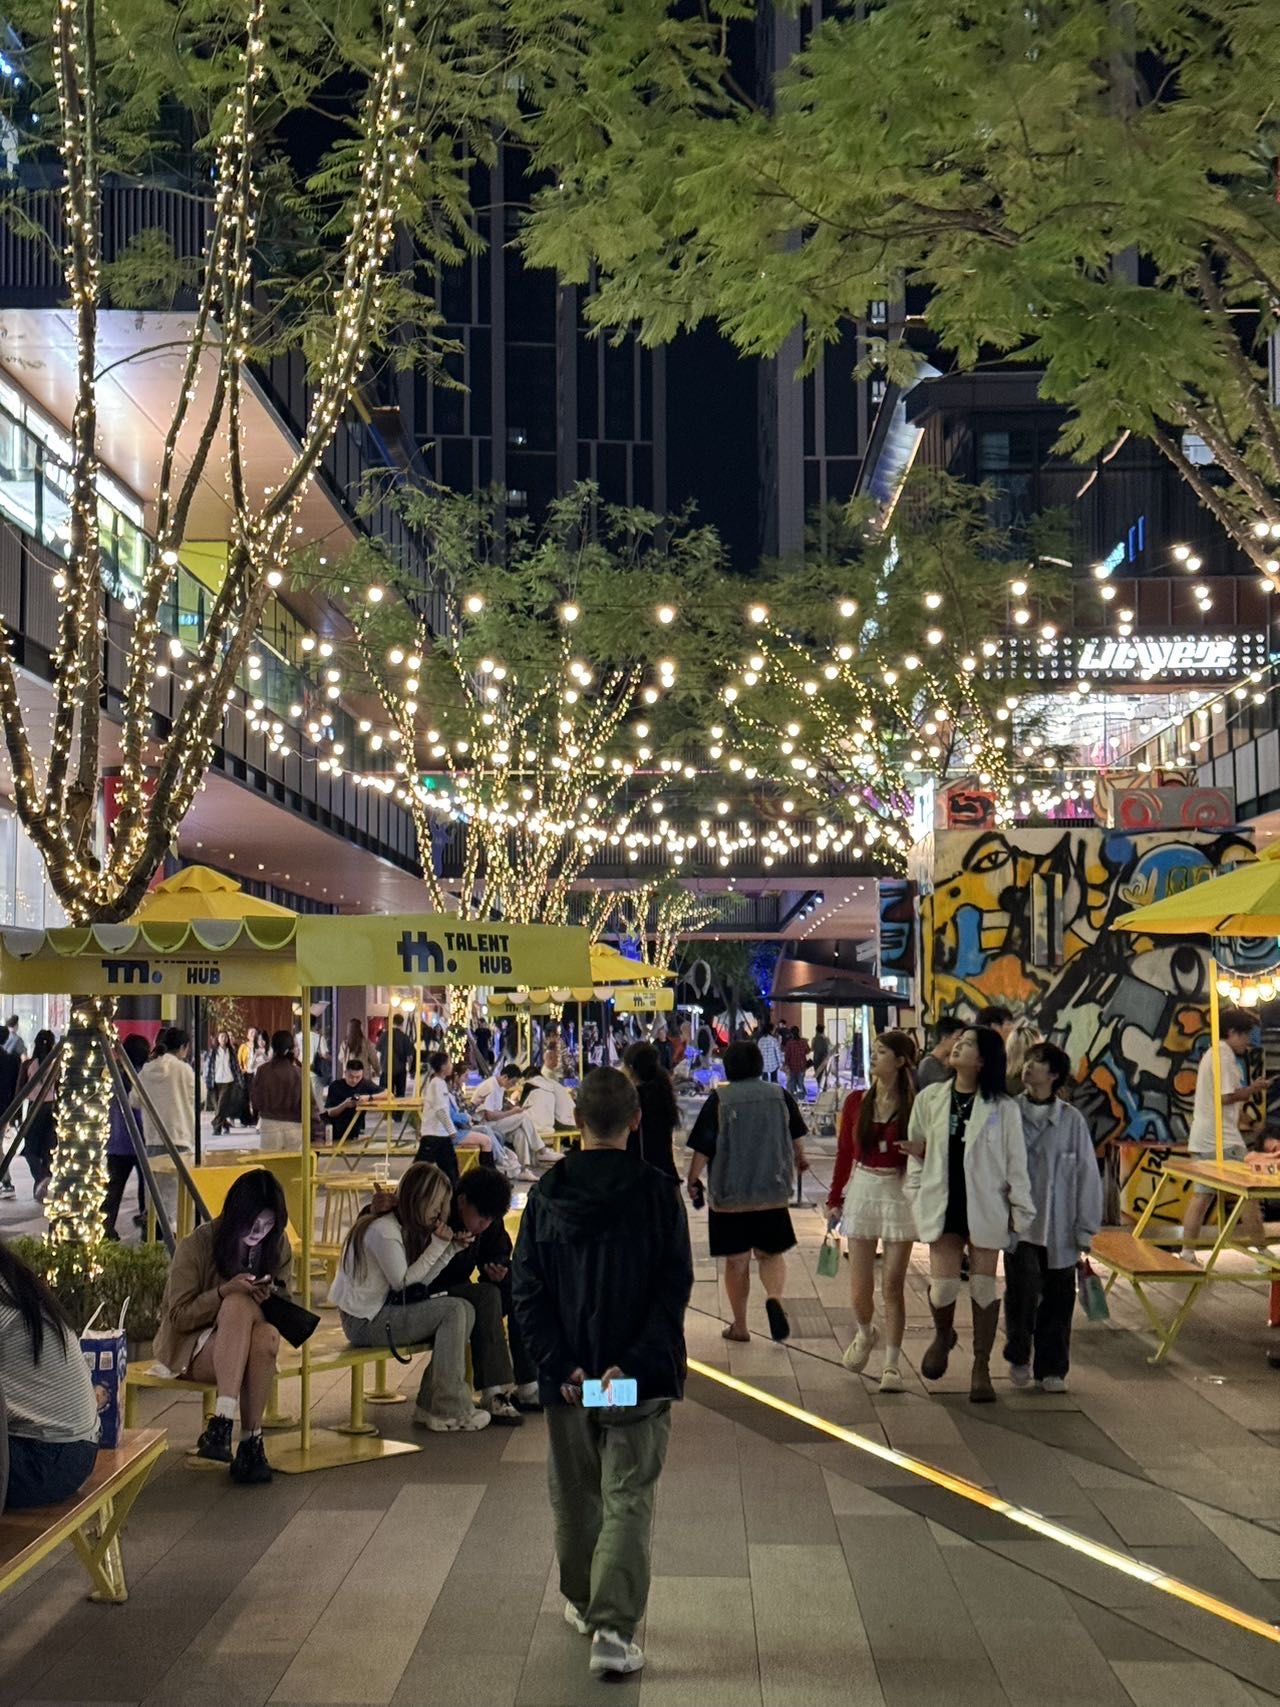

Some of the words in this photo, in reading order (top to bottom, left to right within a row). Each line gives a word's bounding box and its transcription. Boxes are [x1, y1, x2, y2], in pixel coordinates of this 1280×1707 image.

[444, 932, 509, 952] TALENT
[480, 956, 512, 974] HUB
[187, 967, 221, 984] HUB
